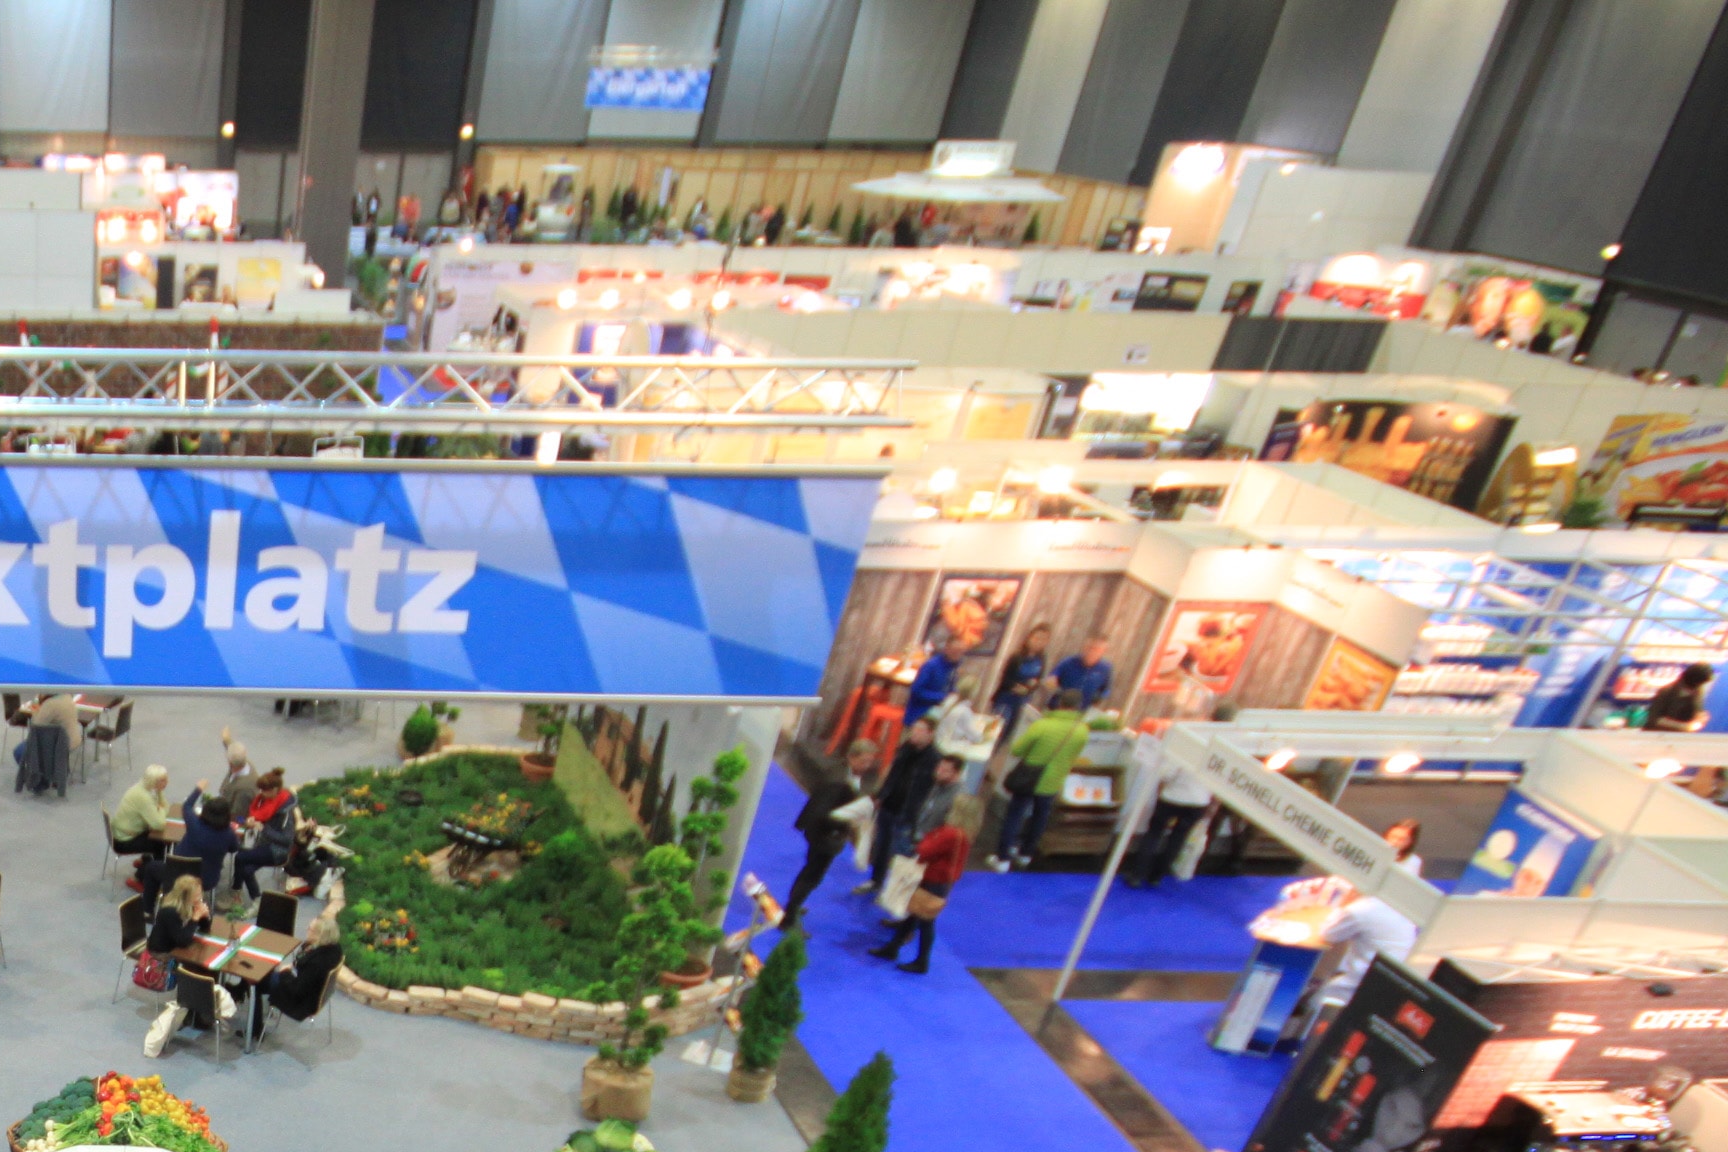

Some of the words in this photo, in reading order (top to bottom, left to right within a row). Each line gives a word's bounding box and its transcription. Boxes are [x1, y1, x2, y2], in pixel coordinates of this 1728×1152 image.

[1229, 767, 1281, 812] SCHNELL
[1284, 805, 1329, 846] CHEMIE
[1333, 834, 1376, 874] GMBH
[1632, 1009, 1728, 1030] COFFEE-
